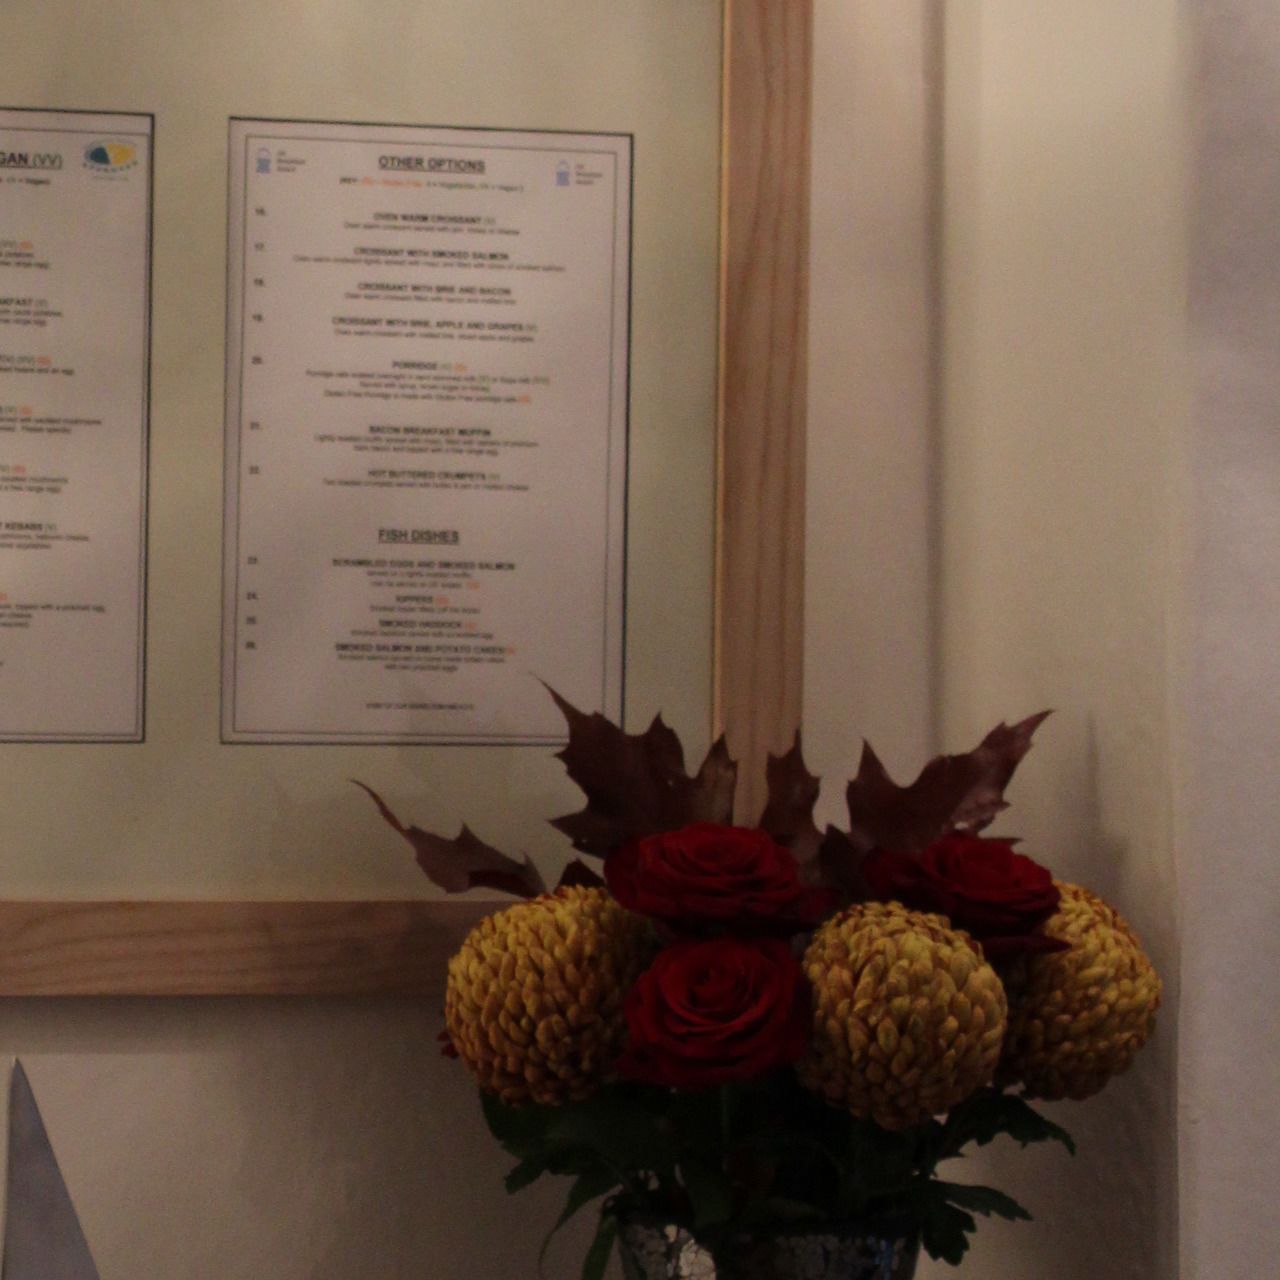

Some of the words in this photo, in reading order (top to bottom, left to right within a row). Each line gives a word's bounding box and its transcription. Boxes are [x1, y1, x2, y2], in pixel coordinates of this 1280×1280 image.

[33, 153, 62, 169] (VV)
[379, 156, 423, 169] OTHER
[429, 158, 485, 172] OPTIONS
[379, 529, 408, 541] FISH
[411, 530, 459, 542] DISHES
